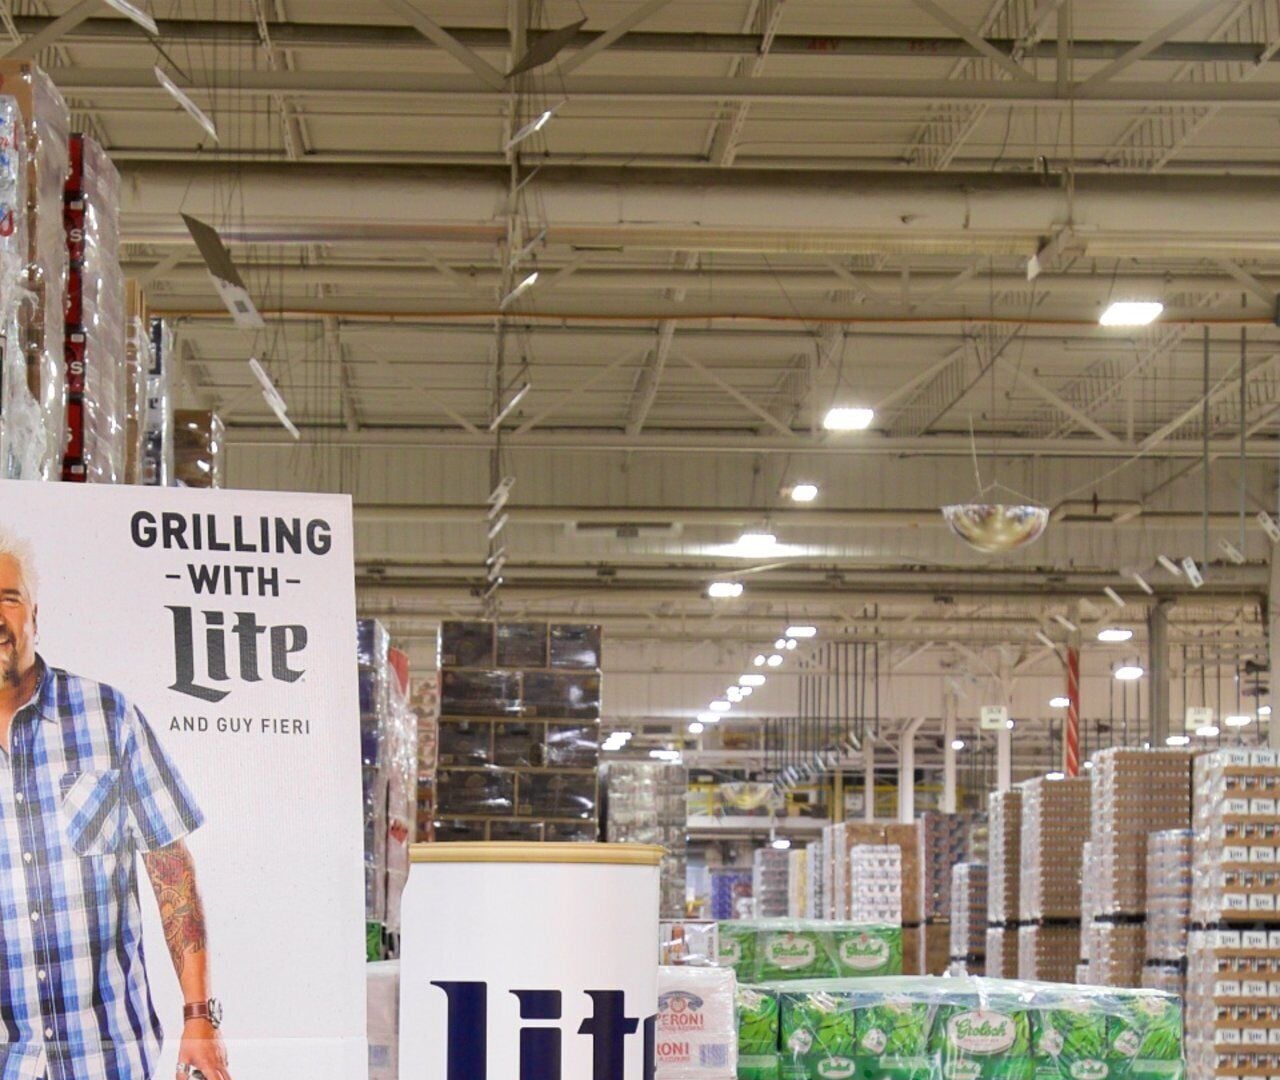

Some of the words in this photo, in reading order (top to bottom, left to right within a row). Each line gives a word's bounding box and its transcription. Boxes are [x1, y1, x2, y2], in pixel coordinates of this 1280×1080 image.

[130, 510, 333, 556] GRILLING
[163, 604, 308, 703] Lite
[169, 715, 210, 733] AND
[216, 716, 255, 734] GUY
[261, 718, 312, 736] FIERI
